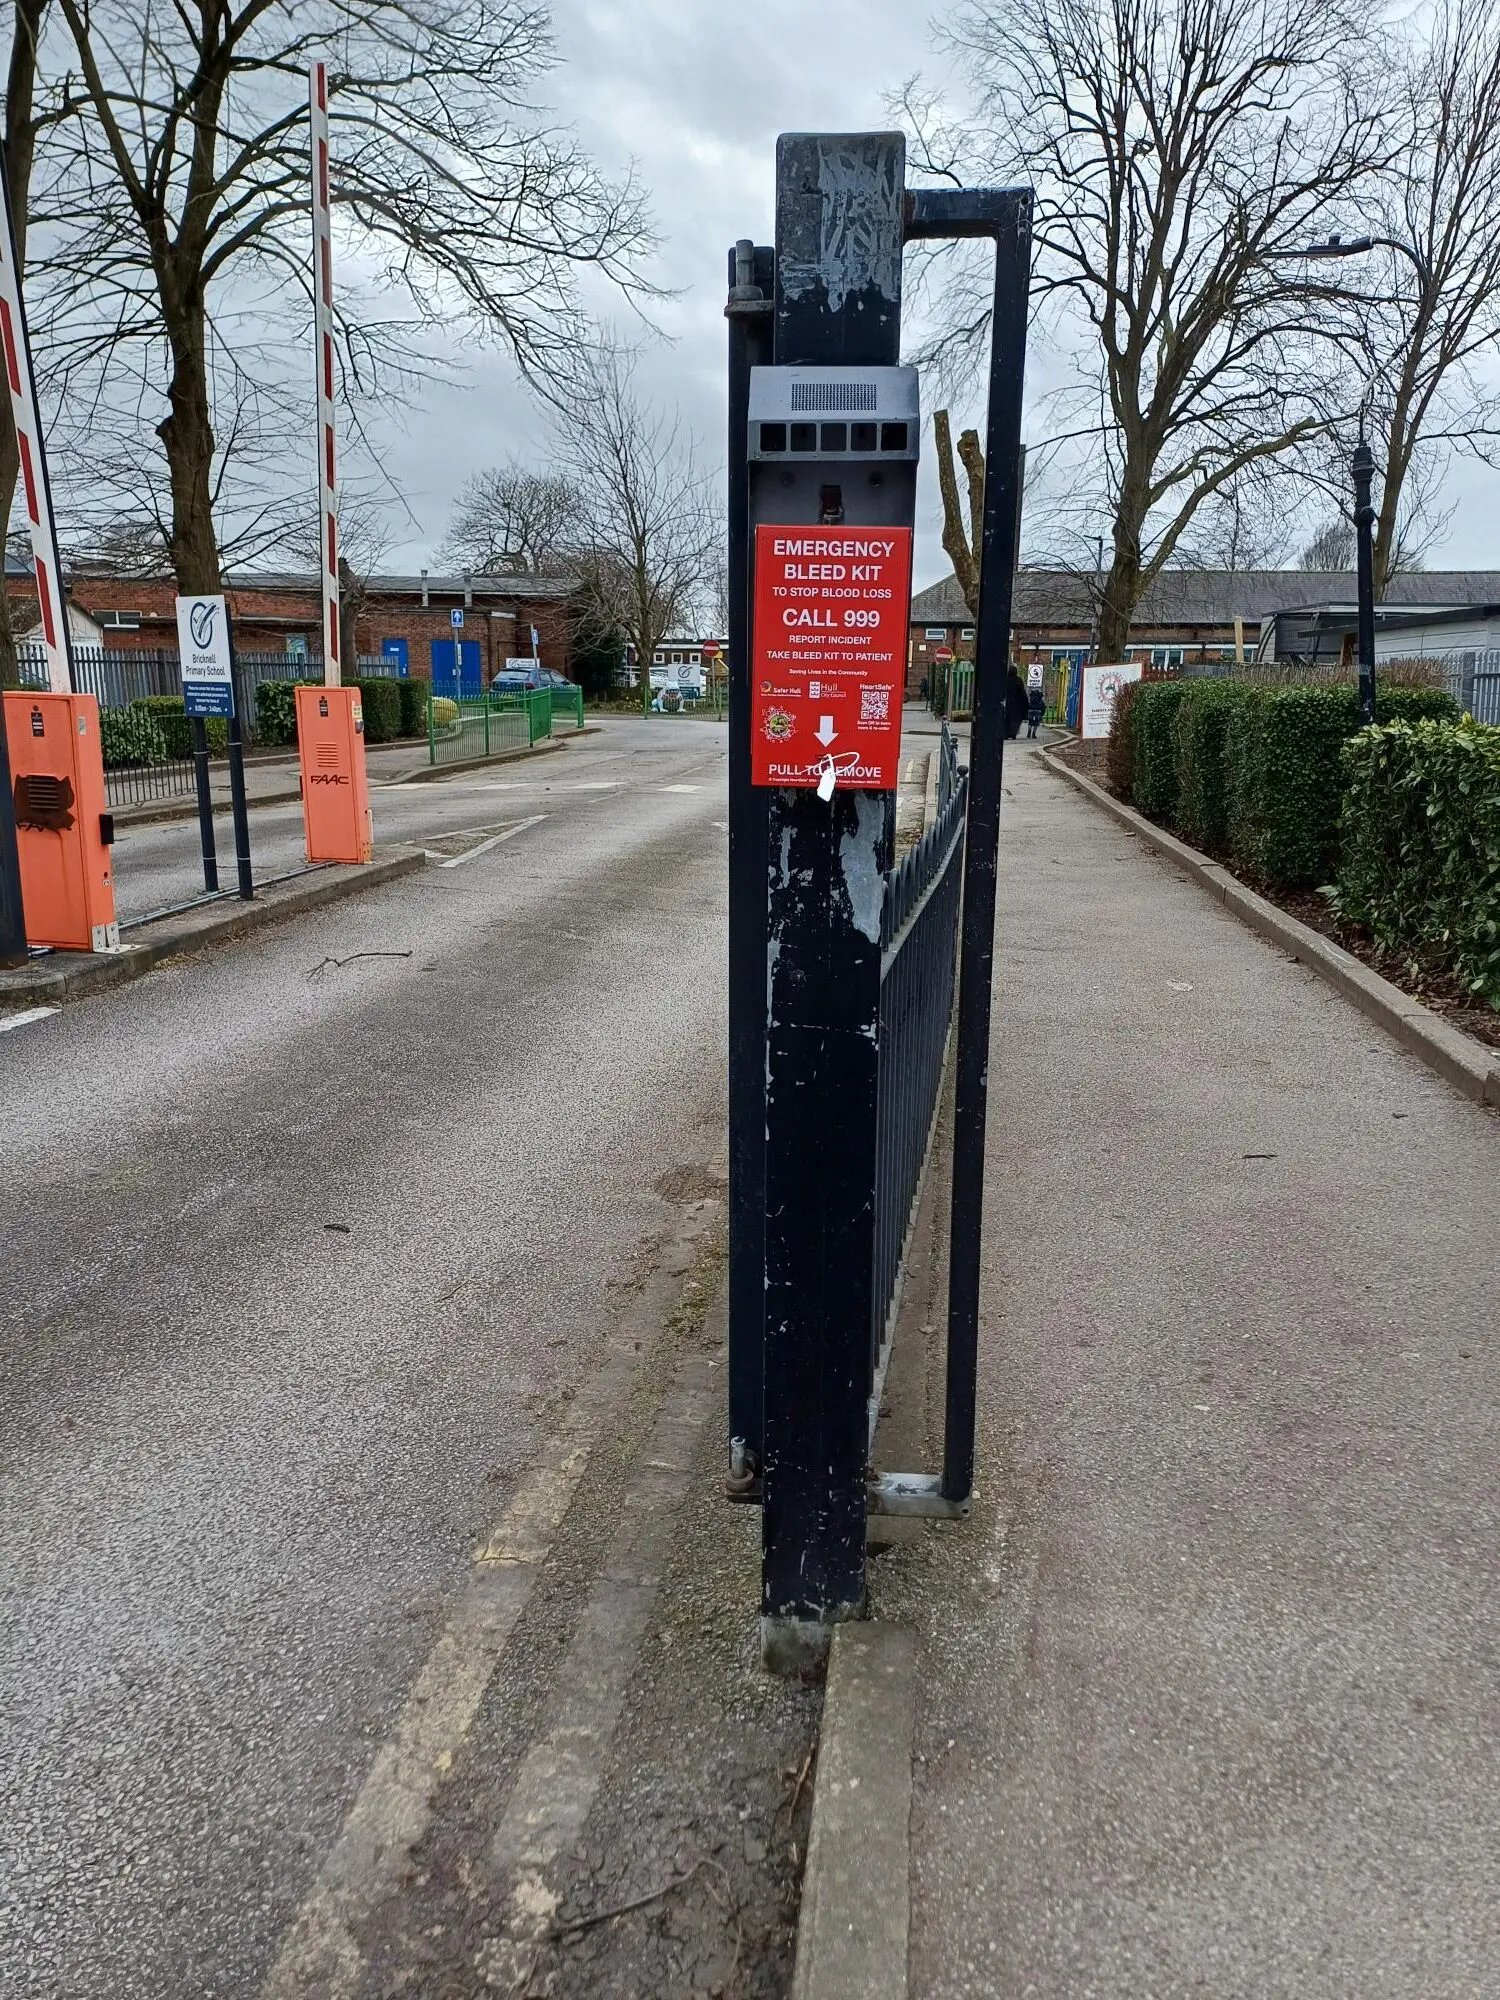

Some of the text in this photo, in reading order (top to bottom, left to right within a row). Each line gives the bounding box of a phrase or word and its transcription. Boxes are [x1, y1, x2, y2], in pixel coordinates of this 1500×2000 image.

[773, 539, 895, 558] EMERGENCY
[784, 564, 882, 581] BLEED KIT
[772, 586, 892, 599] TO STOP BLOOD LOSS
[782, 608, 880, 627] CALL 999
[789, 635, 872, 645] REPORT INCIDENT
[192, 653, 216, 664] Bricknell
[767, 651, 893, 661] TAKE BLEED KIT TO PATIENT
[185, 665, 226, 677] Primary School
[789, 668, 807, 676] Saving
[838, 669, 868, 677] Community
[820, 682, 838, 691] Hull
[768, 764, 802, 775] PULL
[826, 766, 882, 778] EMOVE
[310, 774, 349, 785] FAAC
